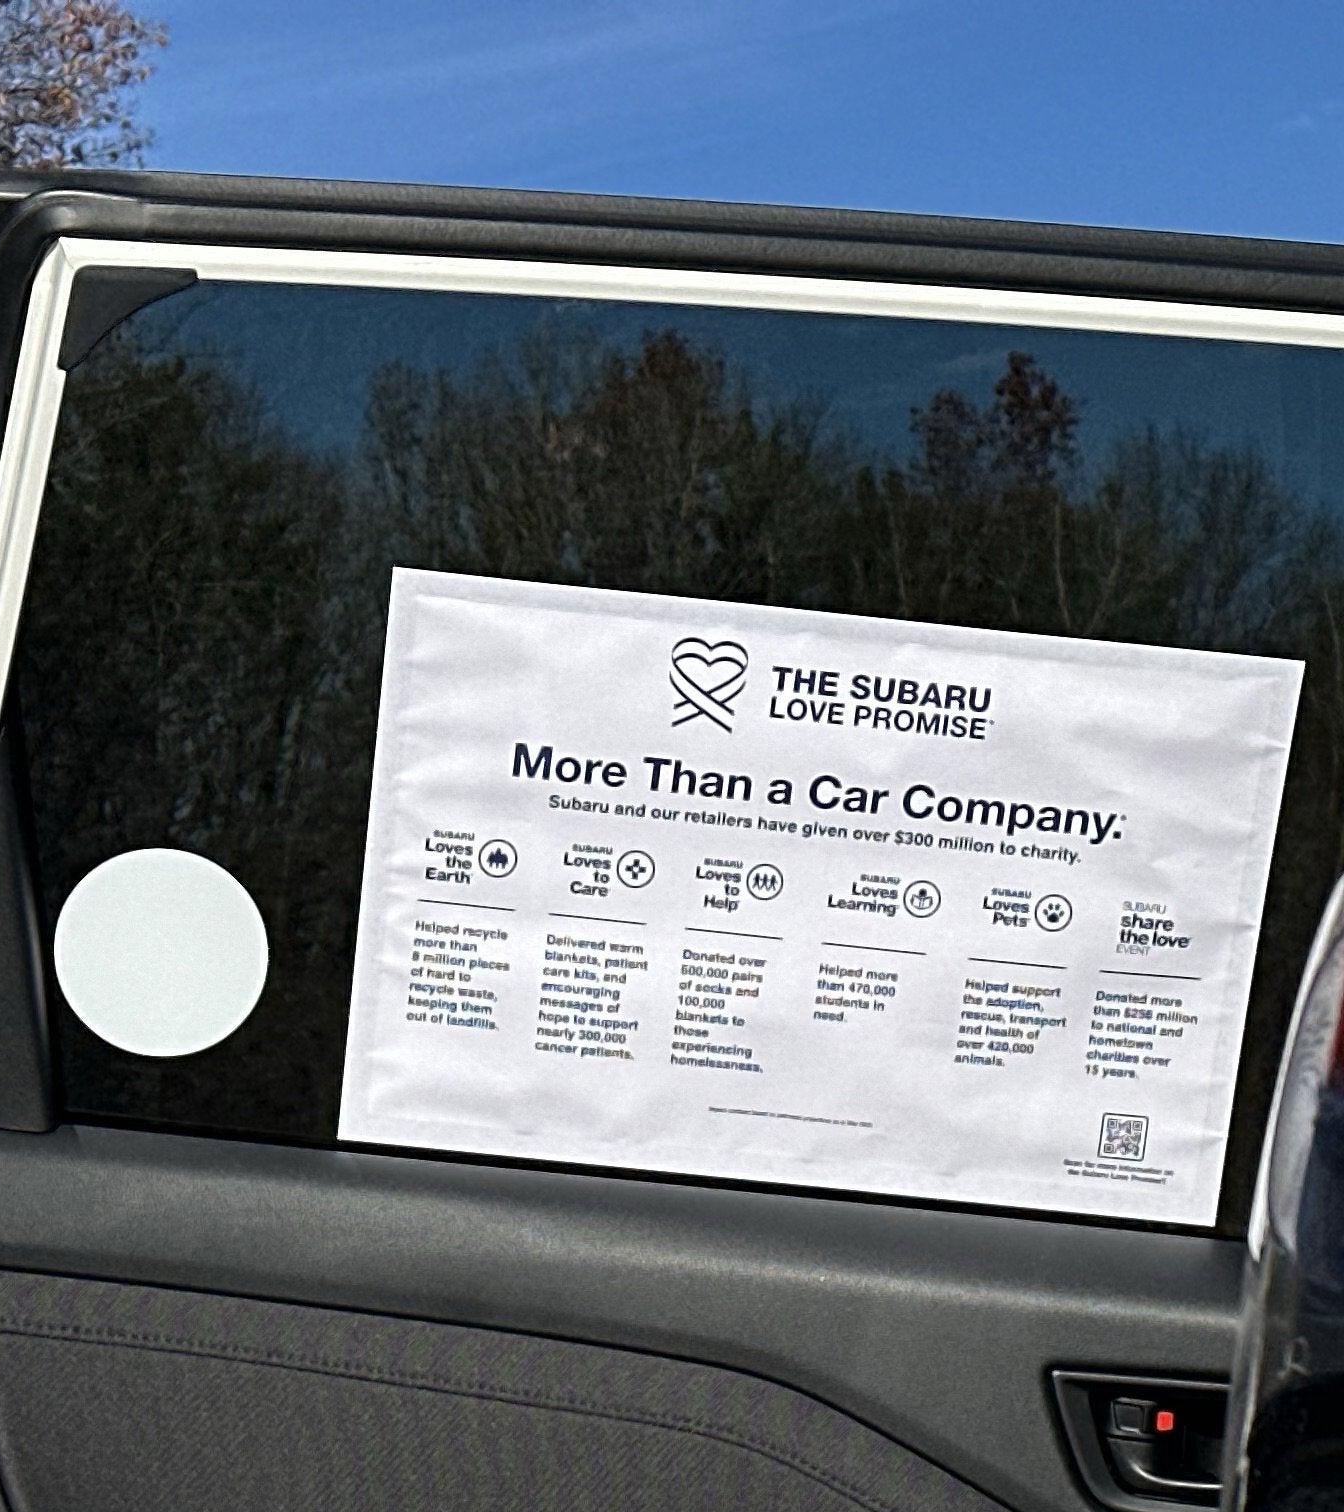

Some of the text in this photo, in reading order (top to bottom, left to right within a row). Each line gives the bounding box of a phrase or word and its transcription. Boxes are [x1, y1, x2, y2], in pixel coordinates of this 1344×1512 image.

[772, 666, 991, 713] THE SUBARU
[769, 696, 845, 725] LOVE
[512, 743, 627, 788] More
[643, 757, 752, 801] Than
[767, 779, 793, 805] a
[809, 775, 890, 814] Car
[549, 794, 1081, 866] Subaru and our retailers have given over $300 million to charity.
[425, 838, 473, 856] Loves
[445, 855, 472, 870] the
[563, 852, 611, 870] Loves
[425, 867, 471, 884] Earth
[593, 870, 610, 884] to
[695, 866, 741, 883] Loves
[570, 881, 609, 897] Care
[724, 883, 740, 896] to
[851, 882, 898, 900] Loves
[704, 894, 740, 911] Help
[827, 895, 899, 916] Learning
[982, 896, 1030, 914] Loves
[992, 911, 1031, 927] Pets
[1120, 913, 1174, 932] share
[415, 920, 508, 941] Helped recycle
[1120, 929, 1191, 948] the love
[413, 937, 477, 952] more than
[546, 934, 644, 955] Delivered warm
[423, 953, 466, 967] million
[469, 957, 510, 971] pieces
[544, 950, 648, 971] blankets, patient
[682, 949, 767, 968] Donated over
[410, 966, 472, 982] of hard to
[543, 967, 627, 984] care kits, and
[731, 971, 763, 983] pairs
[819, 963, 898, 982] Helped more
[408, 982, 498, 1002] recycle waste,
[541, 982, 621, 1001] encouraging
[679, 980, 759, 998] of socks and
[817, 979, 896, 997] than 470,000
[965, 978, 1061, 998] Helped support
[408, 995, 492, 1015] keeping them
[539, 997, 620, 1013] messages of
[678, 994, 725, 1010] 100,000
[815, 995, 885, 1011] students in
[963, 994, 983, 1006] the
[1095, 990, 1183, 1007] Donated more
[406, 1012, 427, 1022] out
[430, 1013, 443, 1025] of
[538, 1010, 639, 1031] hope to support
[675, 1008, 746, 1027] blankets to
[961, 1010, 1067, 1029] rescue, transport
[1093, 1005, 1121, 1017] than
[1155, 1011, 1198, 1025] million
[536, 1027, 626, 1045] nearly 300,000
[673, 1025, 709, 1038] those
[958, 1025, 1040, 1040] and health of
[1091, 1020, 1184, 1038] to national and
[535, 1042, 578, 1054] cancer
[671, 1041, 752, 1059] experiencing
[956, 1040, 1034, 1054] over 420,000
[1088, 1034, 1153, 1050] hometown
[954, 1053, 1005, 1067] animals.
[1086, 1049, 1172, 1067] charities over
[1084, 1064, 1099, 1076] 15
